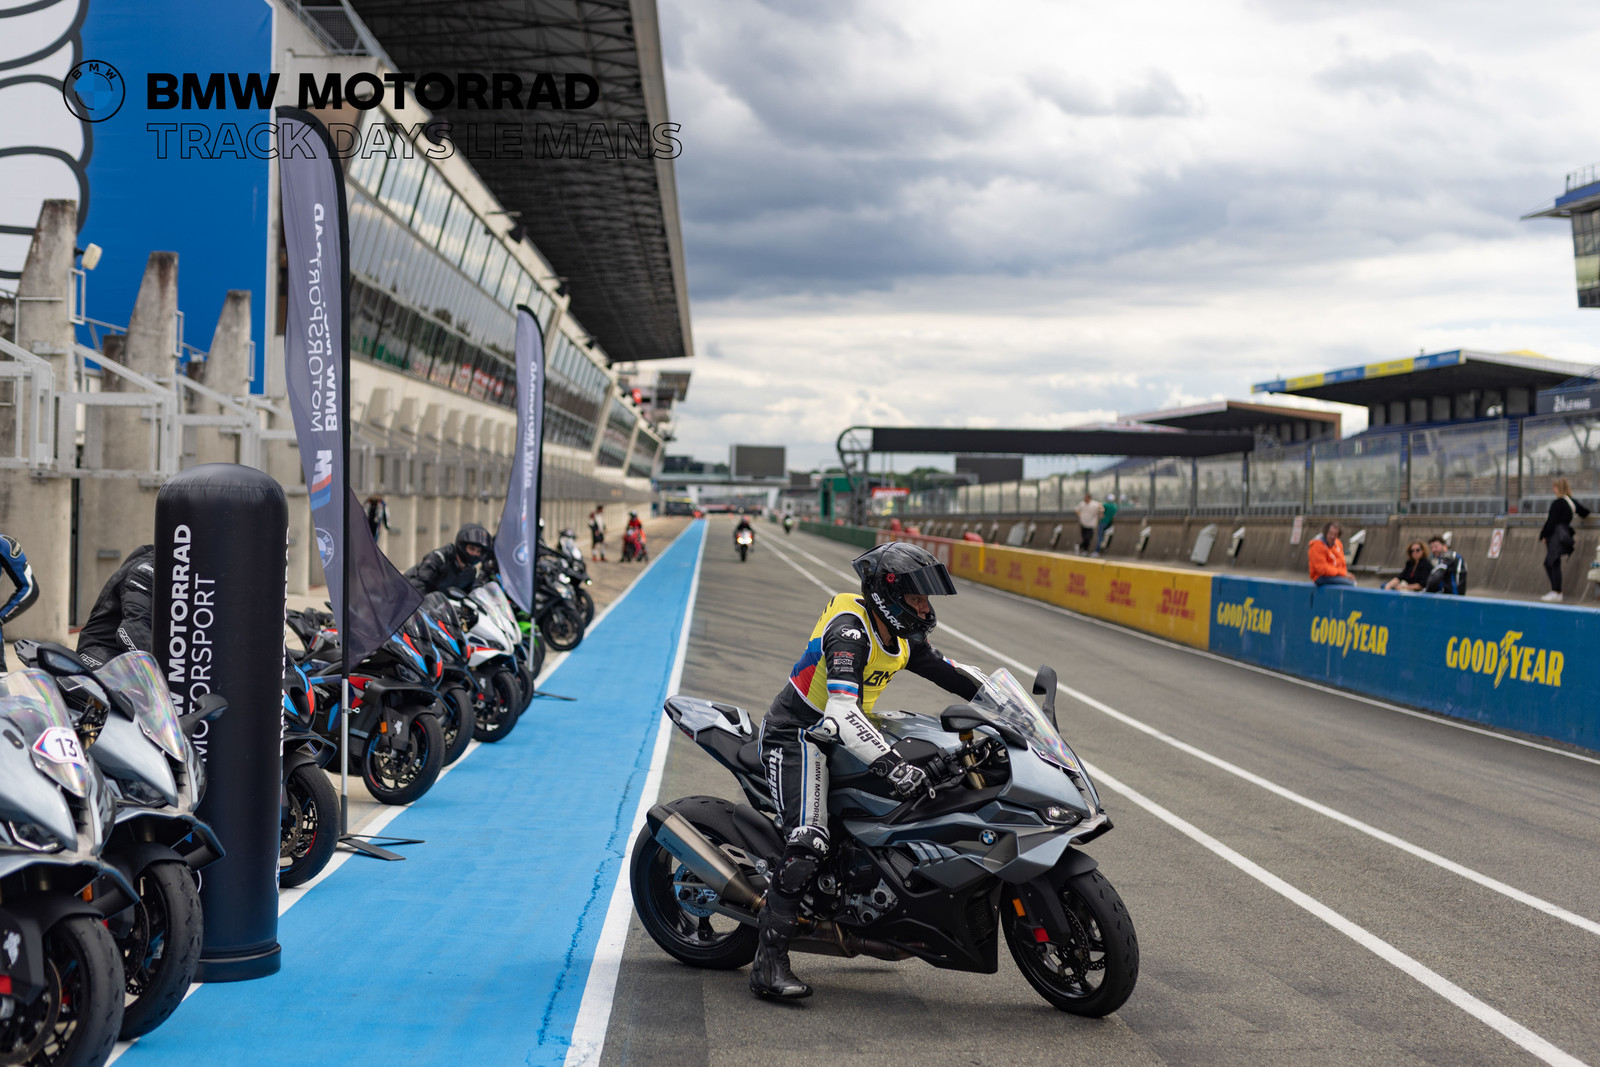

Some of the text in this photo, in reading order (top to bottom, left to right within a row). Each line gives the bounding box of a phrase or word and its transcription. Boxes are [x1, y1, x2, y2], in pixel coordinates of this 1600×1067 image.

[168, 524, 191, 682] MOTORRAD
[871, 592, 906, 631] SHARK
[1217, 597, 1273, 636] GOODYEAR
[1311, 610, 1389, 658] GOODYEAR
[863, 670, 897, 687] BM
[1446, 630, 1565, 688] GOODYEAR
